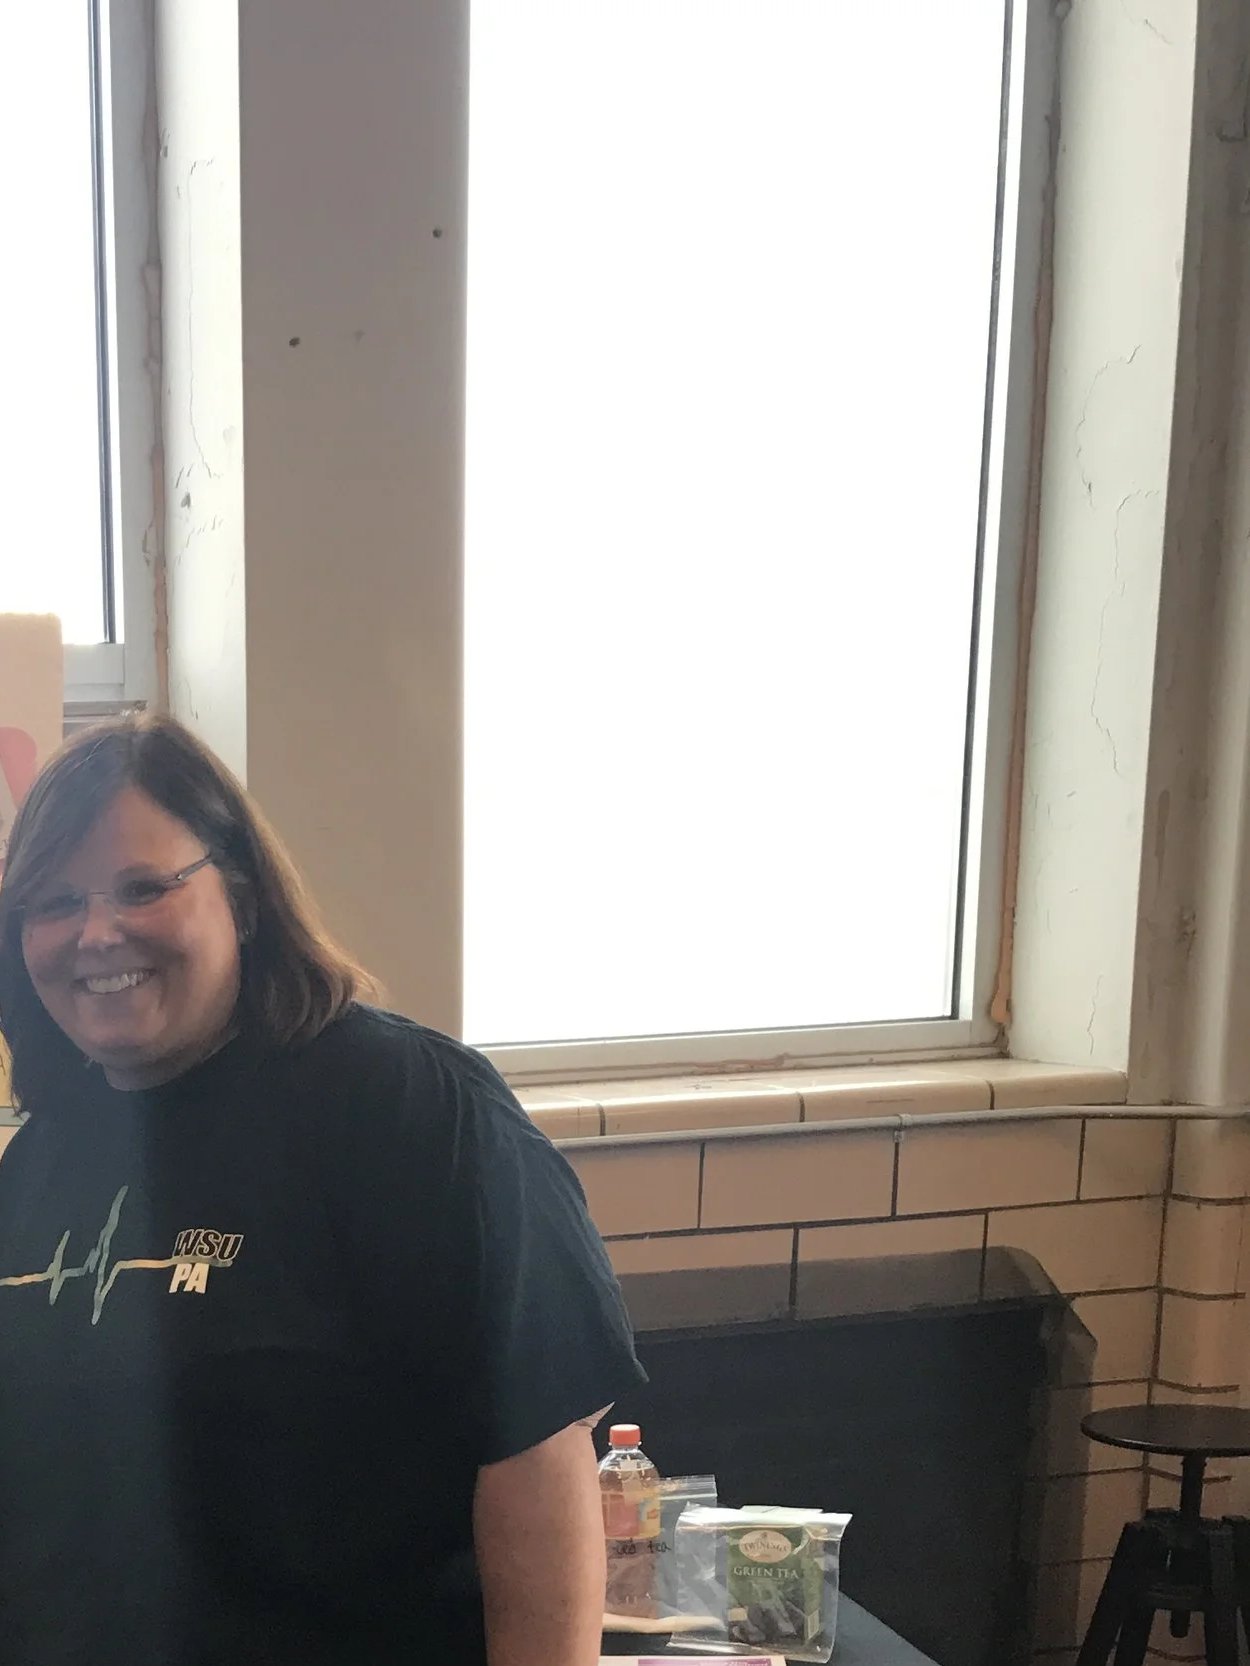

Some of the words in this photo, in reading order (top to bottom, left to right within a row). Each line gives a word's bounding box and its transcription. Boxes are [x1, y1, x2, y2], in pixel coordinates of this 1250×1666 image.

[174, 1229, 245, 1261] WSU
[168, 1263, 210, 1294] PA
[733, 1566, 774, 1577] GREEN
[777, 1567, 800, 1580] TEA
